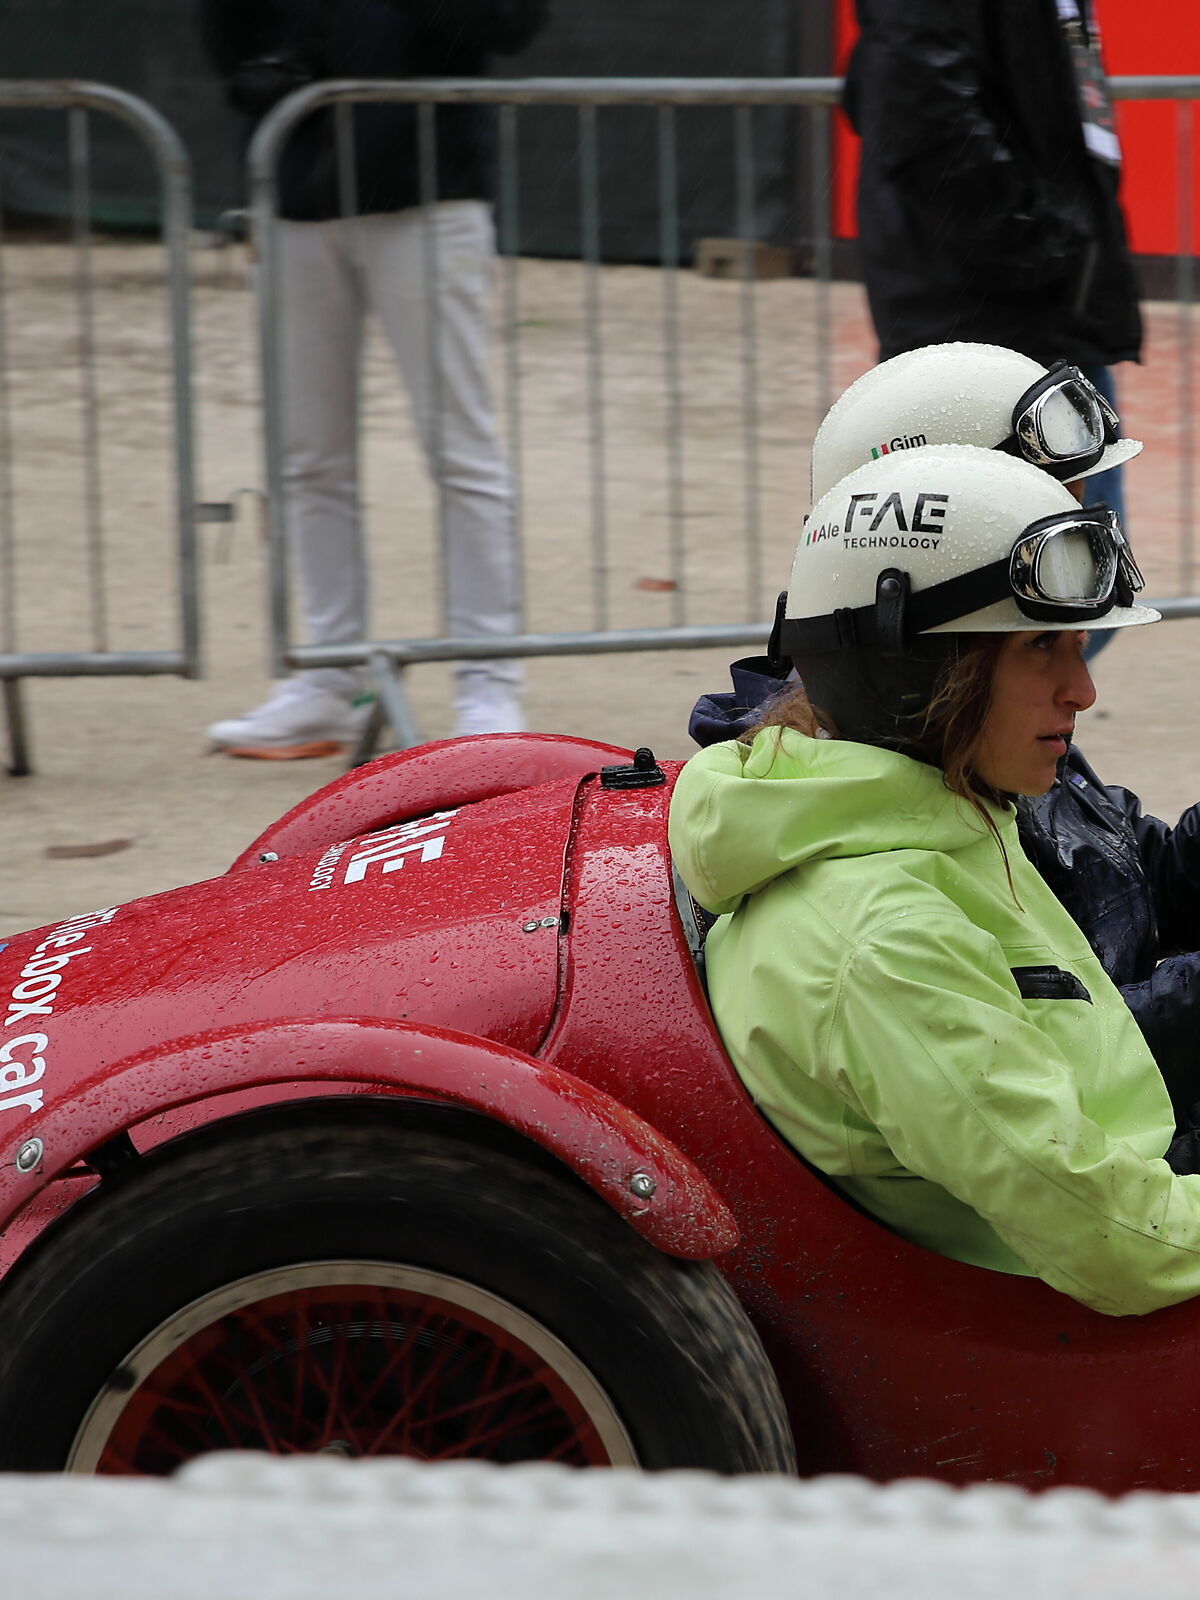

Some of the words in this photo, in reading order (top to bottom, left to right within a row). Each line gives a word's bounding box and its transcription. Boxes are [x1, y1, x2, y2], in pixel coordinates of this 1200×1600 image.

[890, 434, 927, 451] Gim
[844, 493, 949, 534] FAE
[817, 523, 840, 541] Ale
[844, 536, 940, 550] TECHNOLOGY
[0, 1033, 49, 1114] car
